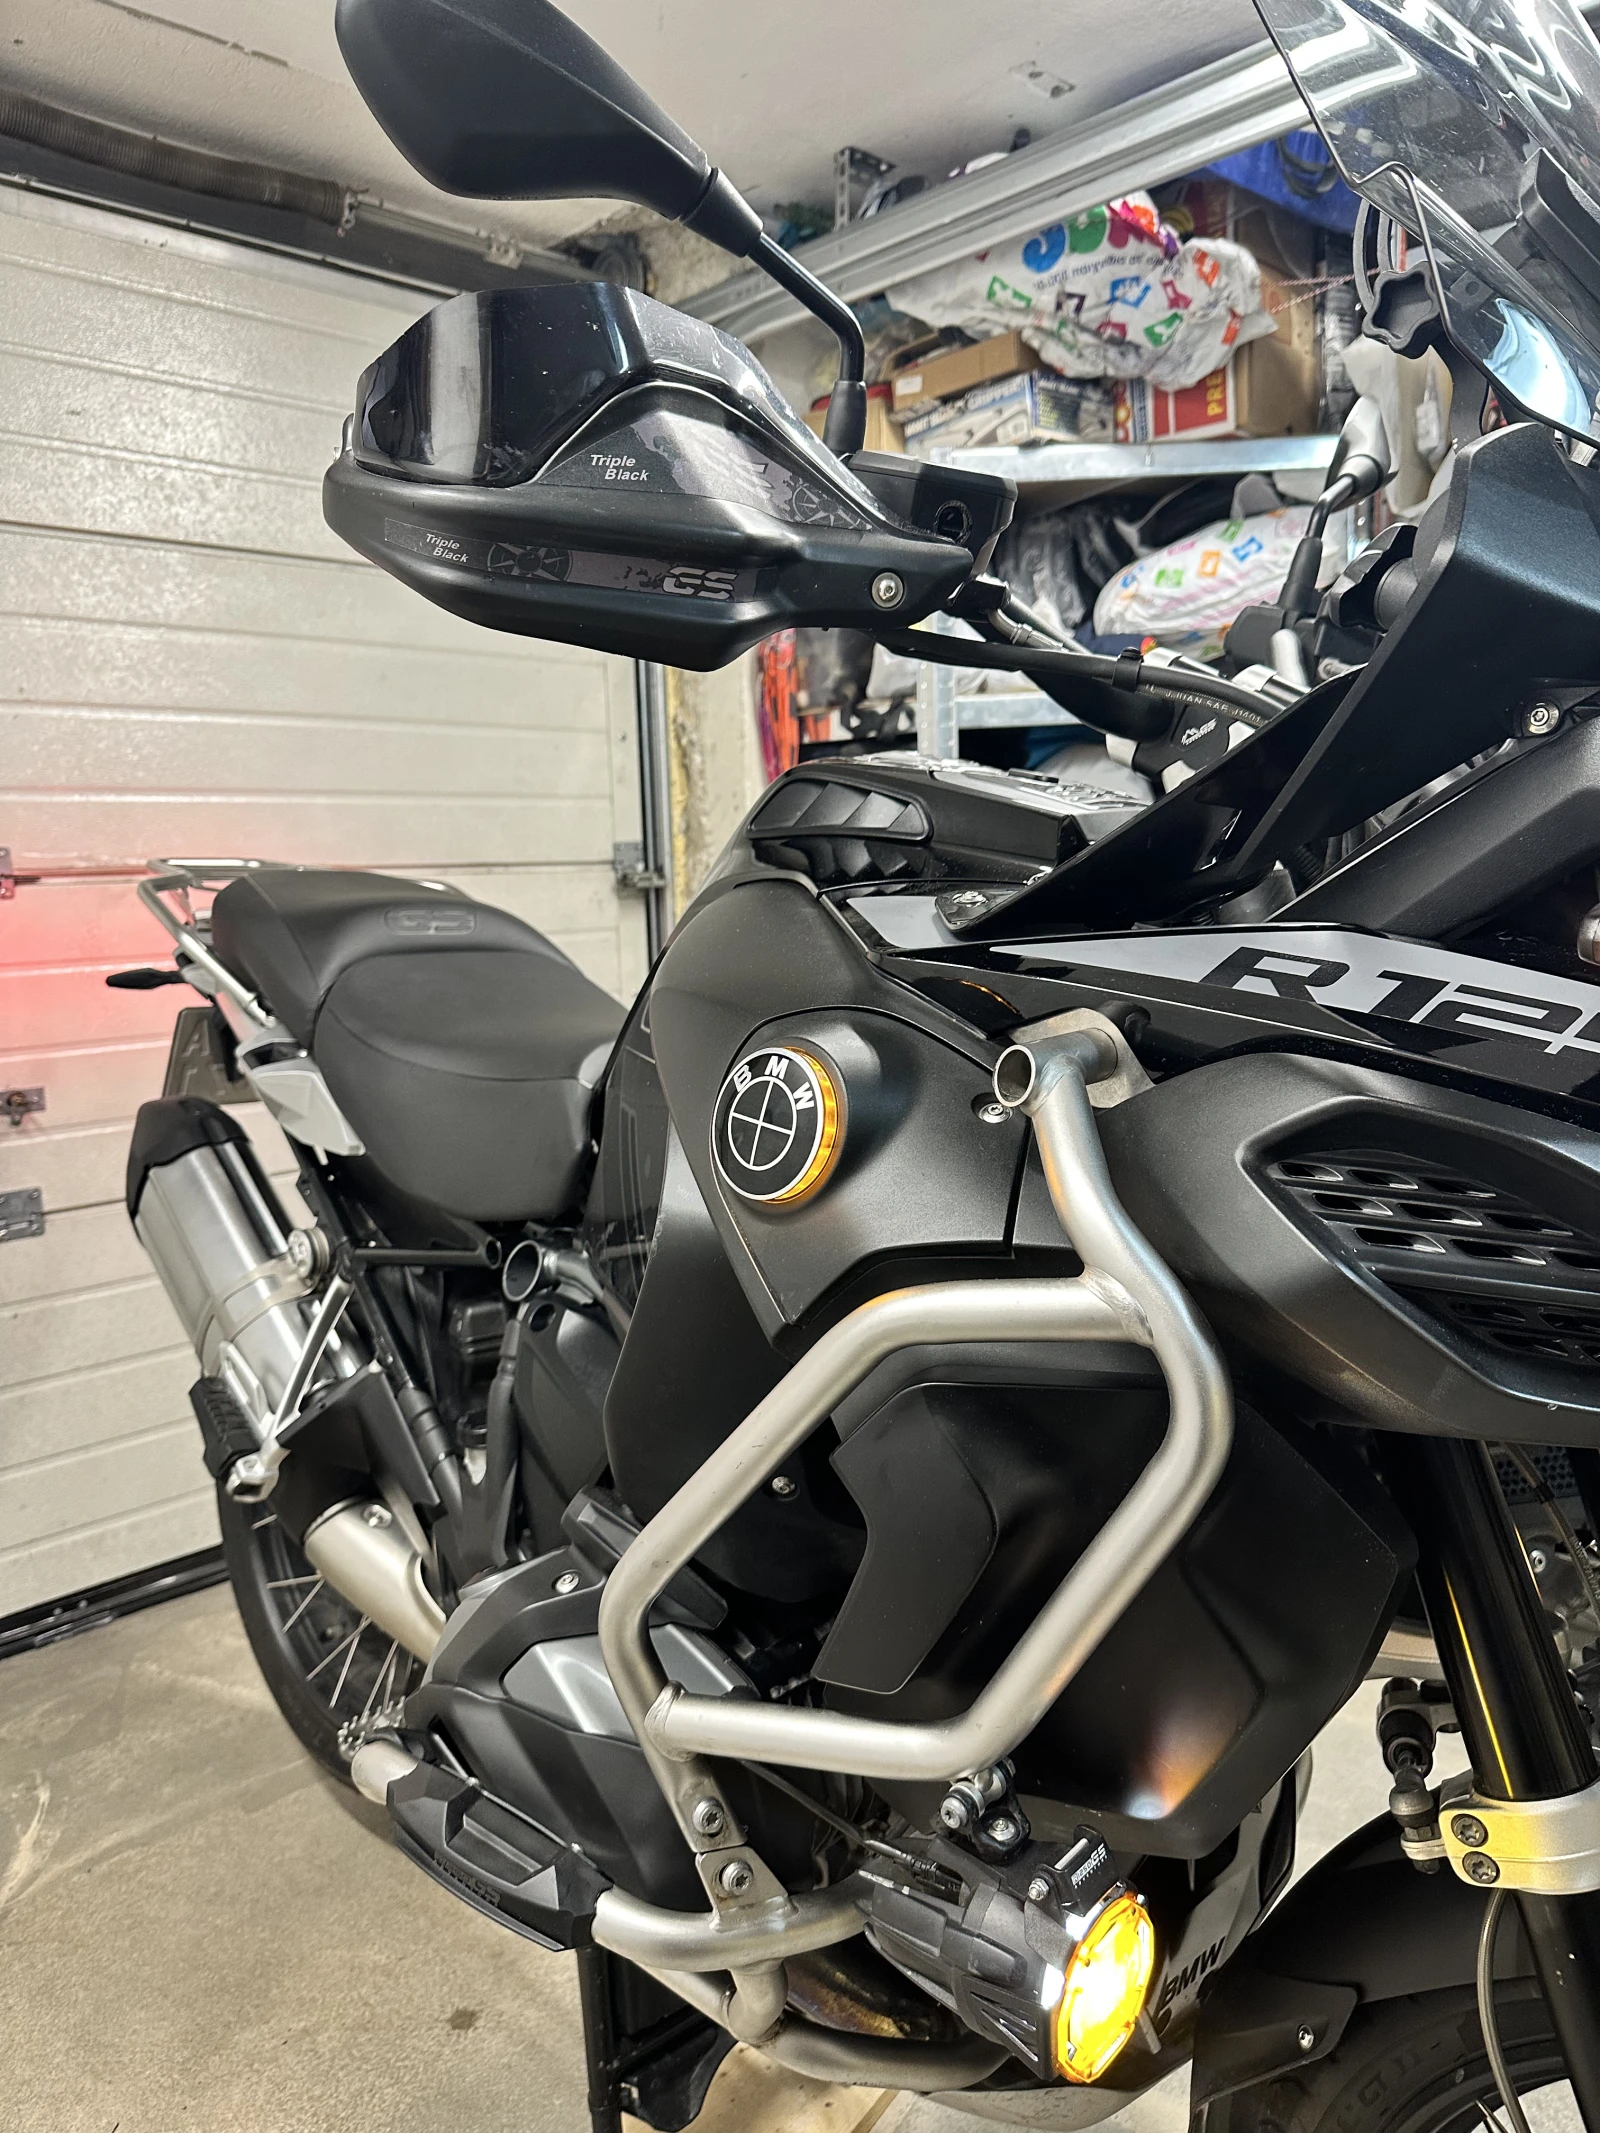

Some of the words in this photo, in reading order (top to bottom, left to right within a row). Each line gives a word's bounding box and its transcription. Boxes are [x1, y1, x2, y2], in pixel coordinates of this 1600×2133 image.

[590, 454, 636, 468] Triple
[604, 468, 649, 481] Black
[426, 533, 460, 549] Triple
[433, 547, 469, 562] Black
[662, 565, 738, 600] GS
[733, 1055, 815, 1111] BMW
[1153, 1935, 1227, 2018] BMW
